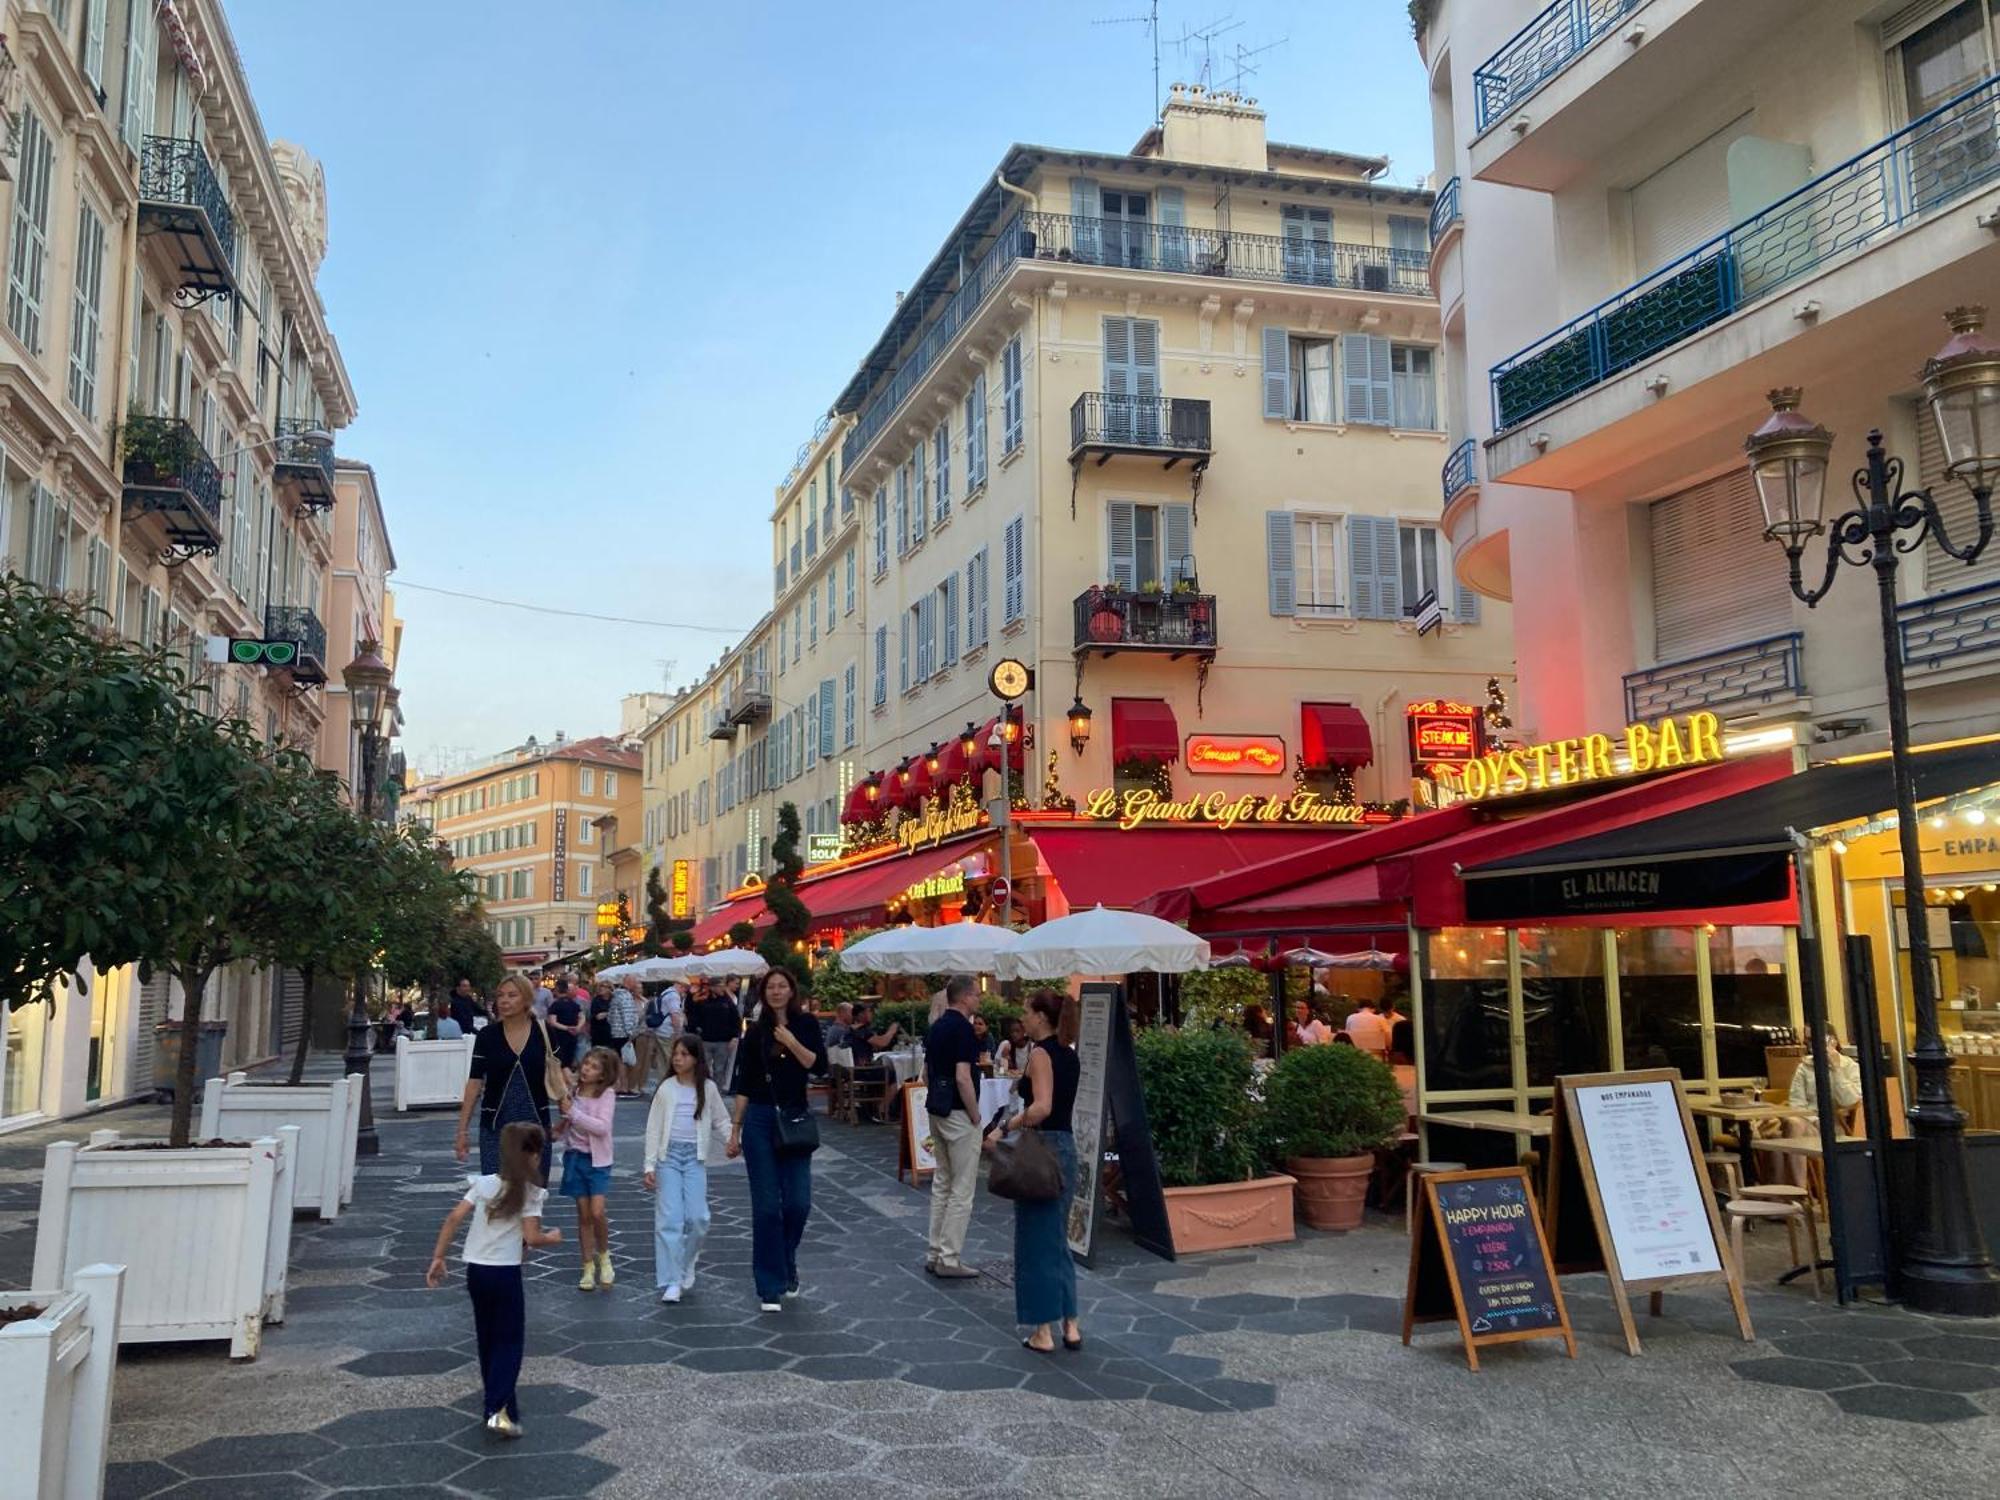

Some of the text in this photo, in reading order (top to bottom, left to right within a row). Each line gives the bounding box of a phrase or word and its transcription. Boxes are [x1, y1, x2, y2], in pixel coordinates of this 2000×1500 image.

[1421, 730, 1456, 745] STEAK
[1463, 711, 1723, 800] OYSTER BAR
[1081, 788, 1365, 830] Le Grand Café de France
[556, 808, 565, 847] HOTEL
[816, 838, 841, 847] HOTE
[1562, 871, 1660, 899] EL ALMACEN
[1446, 1203, 1526, 1224] HAPPY HOUR
[1501, 1283, 1515, 1293] DAY
